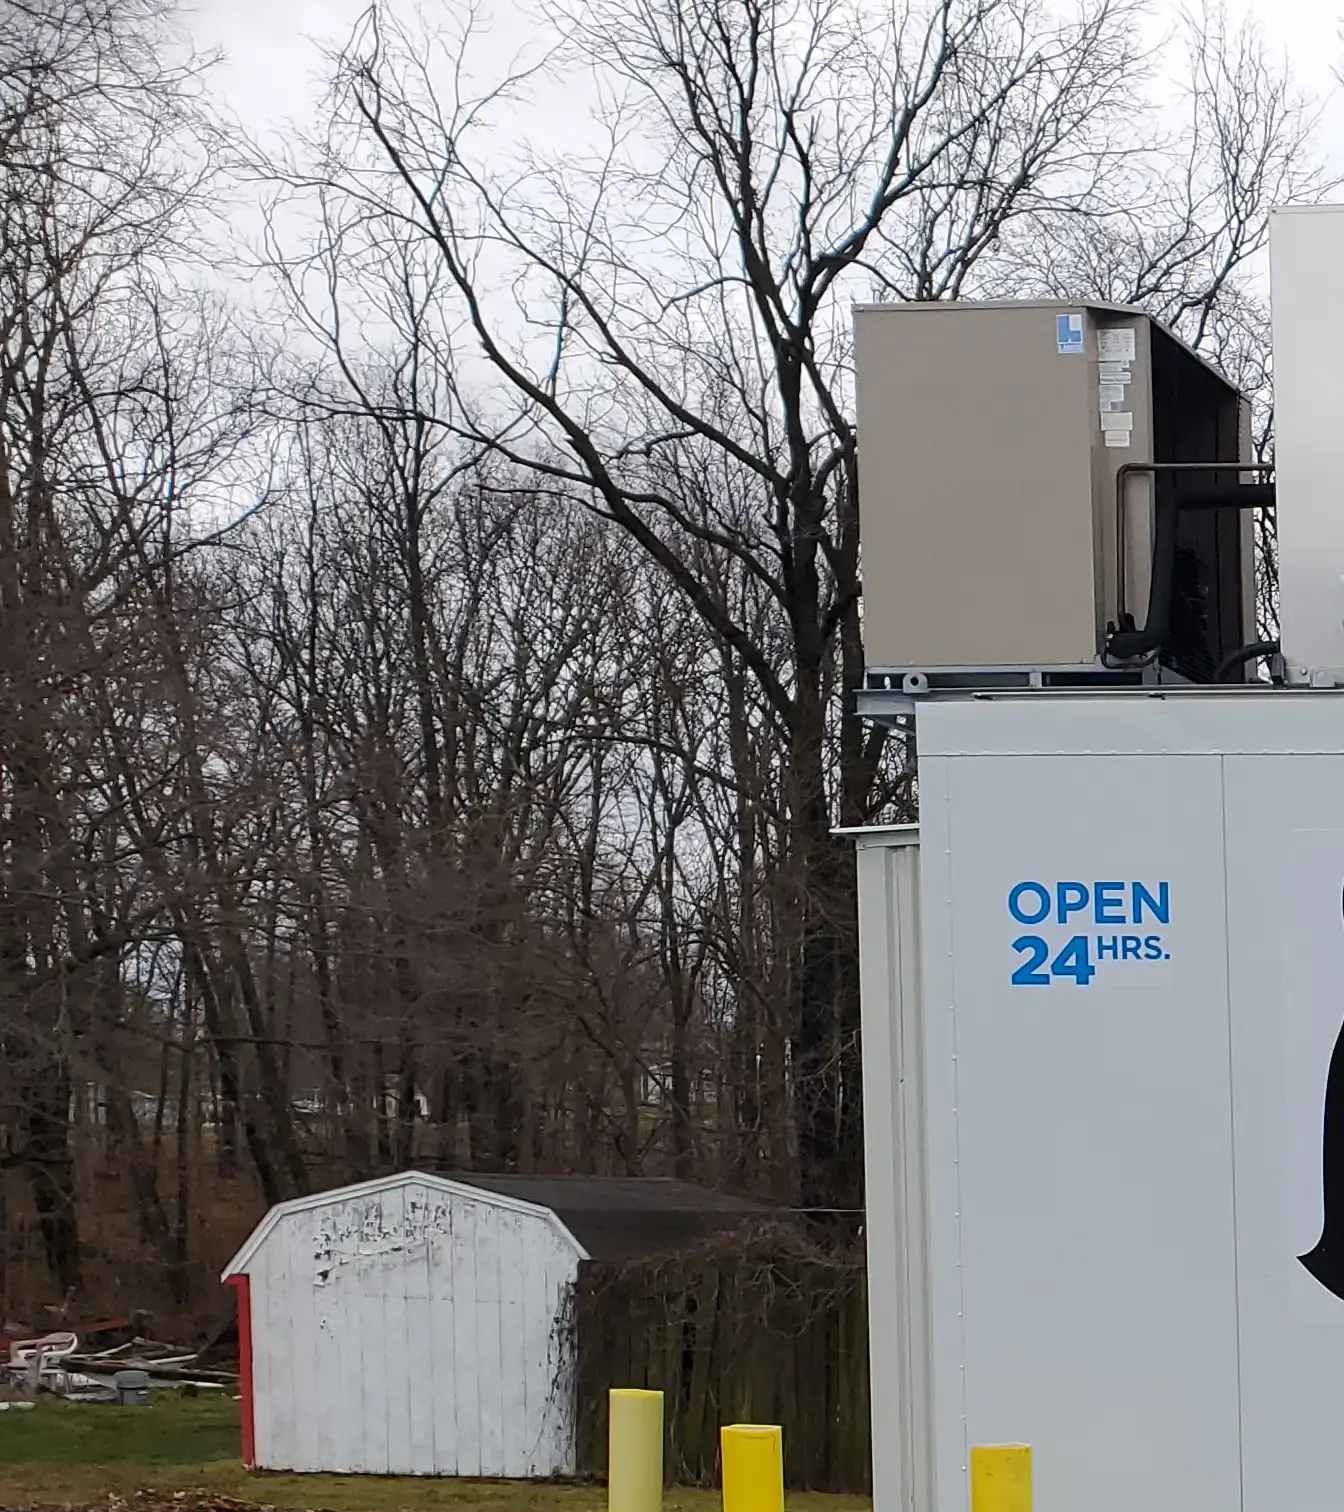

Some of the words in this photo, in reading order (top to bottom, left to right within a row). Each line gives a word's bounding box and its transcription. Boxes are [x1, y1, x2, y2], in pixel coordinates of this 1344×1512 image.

[1008, 881, 1170, 925] OPEN
[1010, 934, 1096, 986] 24
[1096, 934, 1171, 961] HRS.
